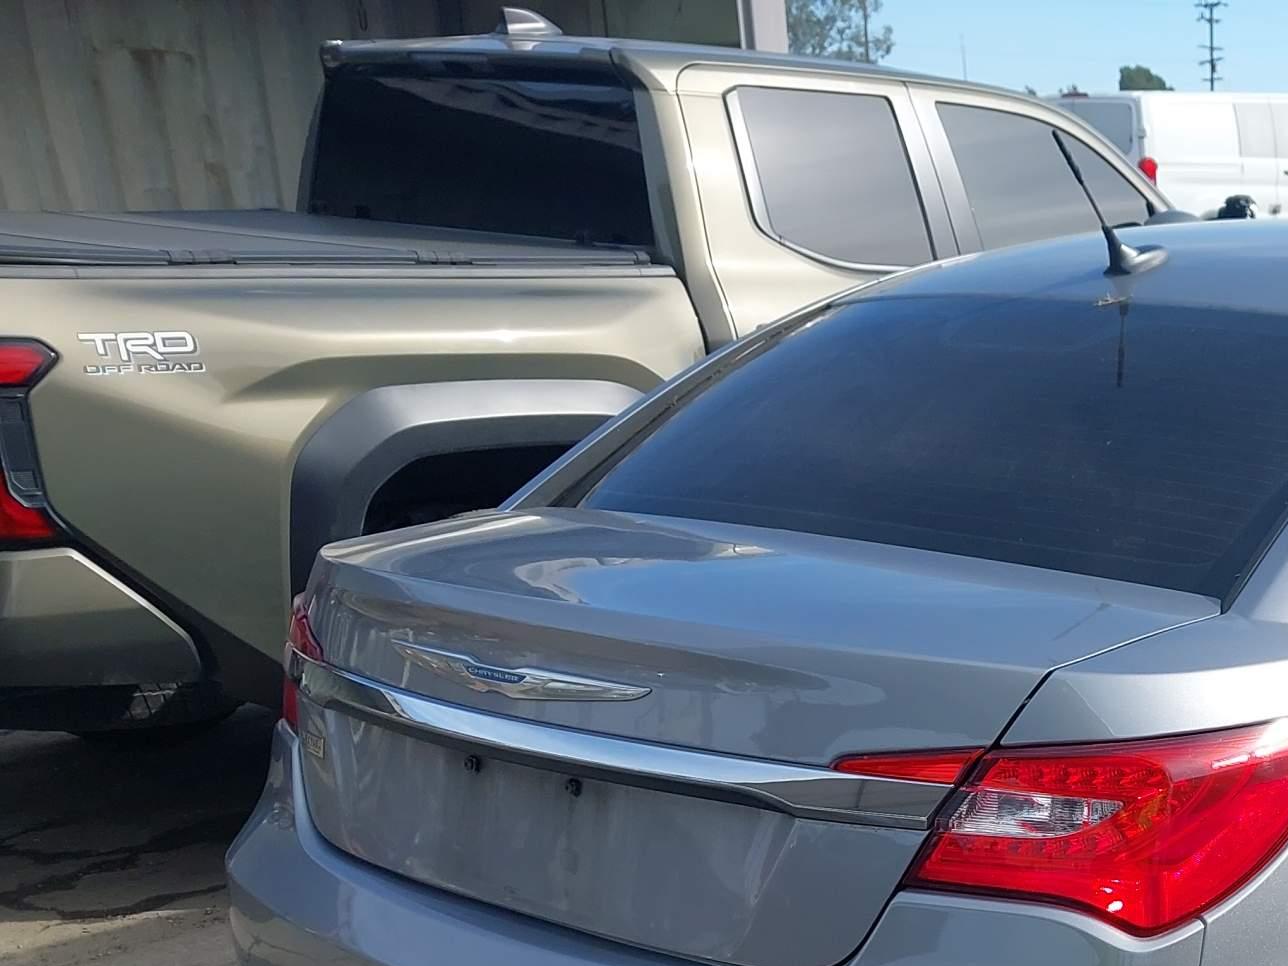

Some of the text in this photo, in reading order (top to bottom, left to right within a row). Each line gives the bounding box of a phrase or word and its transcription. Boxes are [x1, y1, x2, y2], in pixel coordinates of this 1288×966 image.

[77, 331, 198, 362] TRD
[83, 361, 207, 376] OFF ROAD
